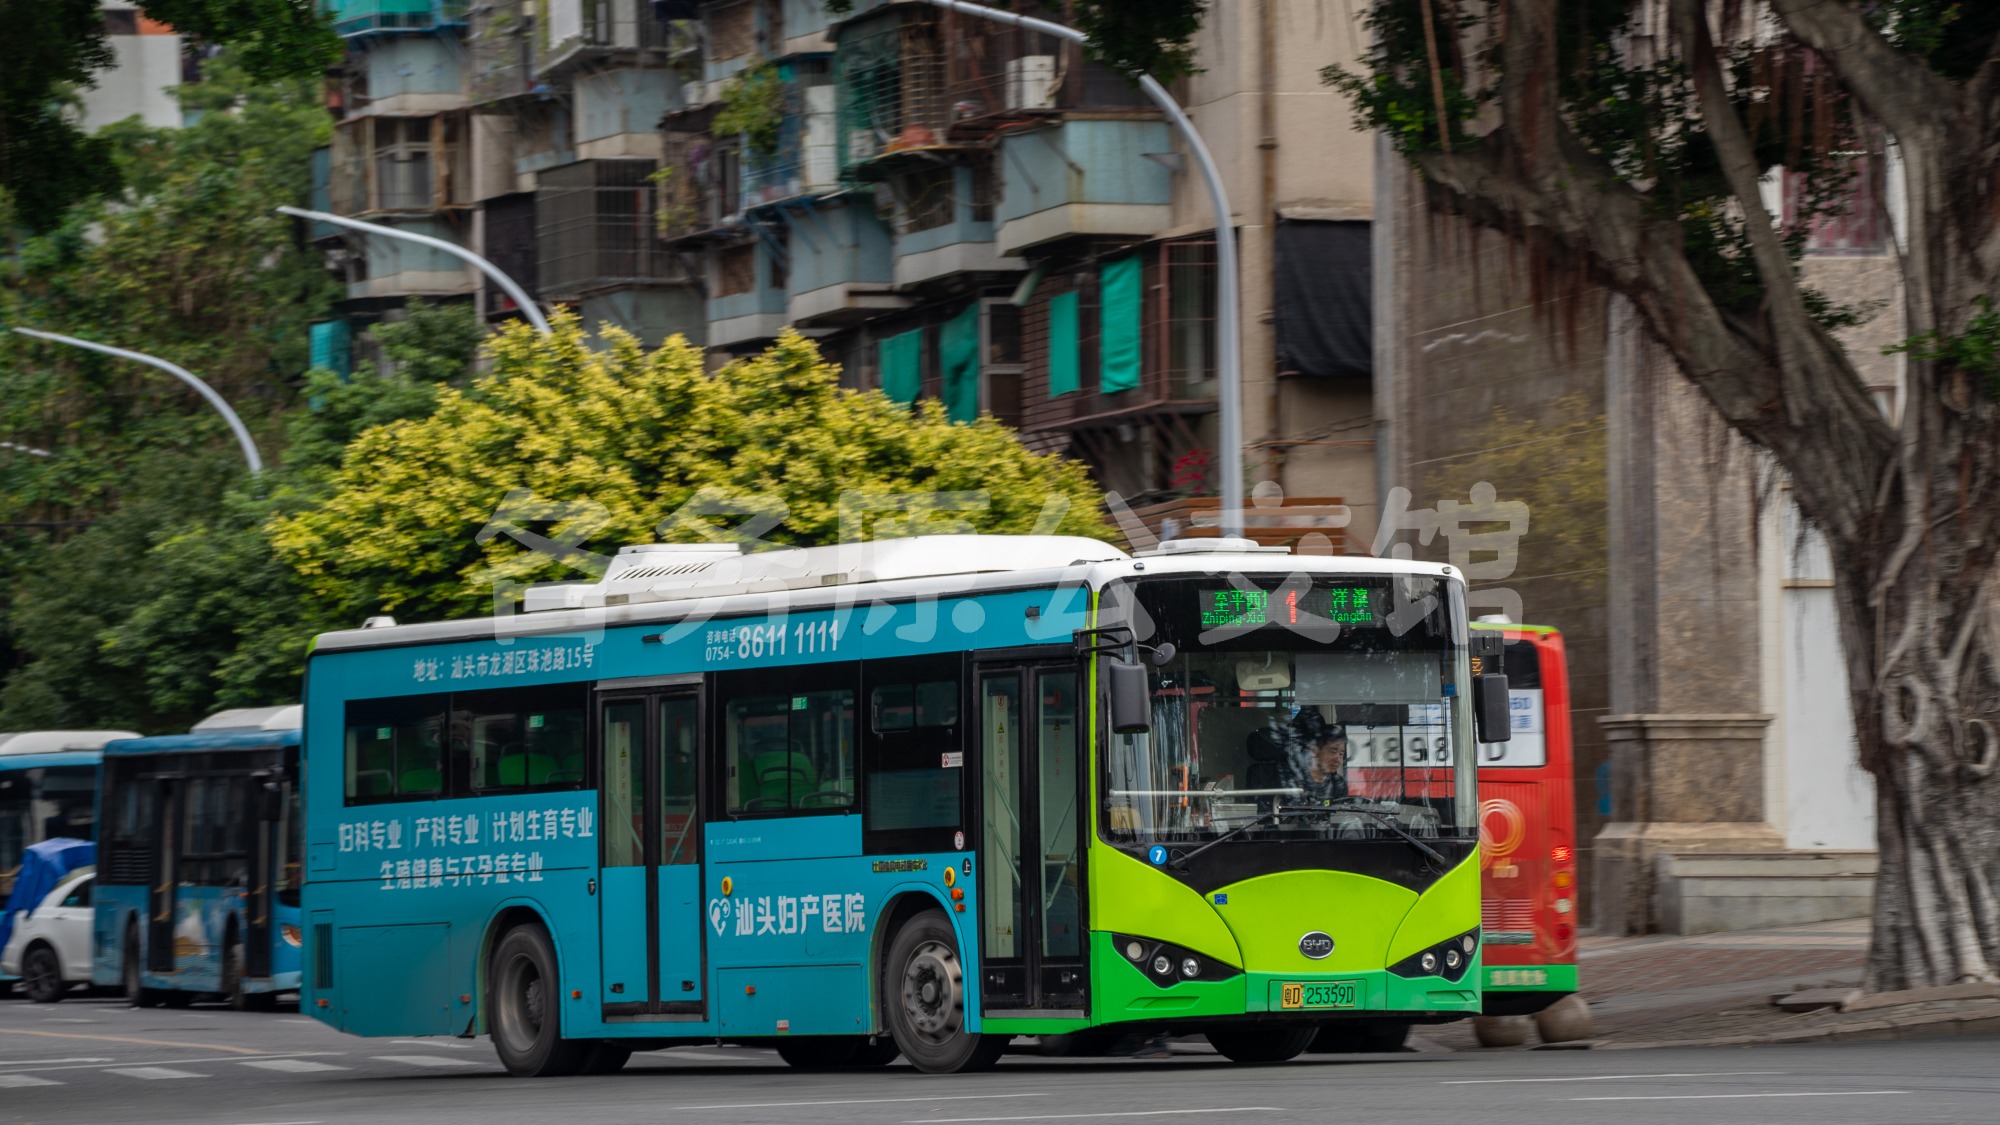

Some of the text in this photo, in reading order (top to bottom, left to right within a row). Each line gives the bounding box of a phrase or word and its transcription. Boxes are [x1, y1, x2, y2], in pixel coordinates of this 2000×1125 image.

[1285, 589, 1297, 624] 1
[1329, 610, 1372, 624] Yangbin
[706, 629, 736, 645] 咨询电话
[738, 624, 786, 659] 8611
[794, 619, 838, 654] 1111
[338, 807, 593, 852] 妇科专业 产科专业 计划生育专业
[380, 852, 543, 890] 生殖健康与不孕症专业
[735, 892, 866, 937] 汕头妇产医院
[1303, 939, 1331, 950] BYD
